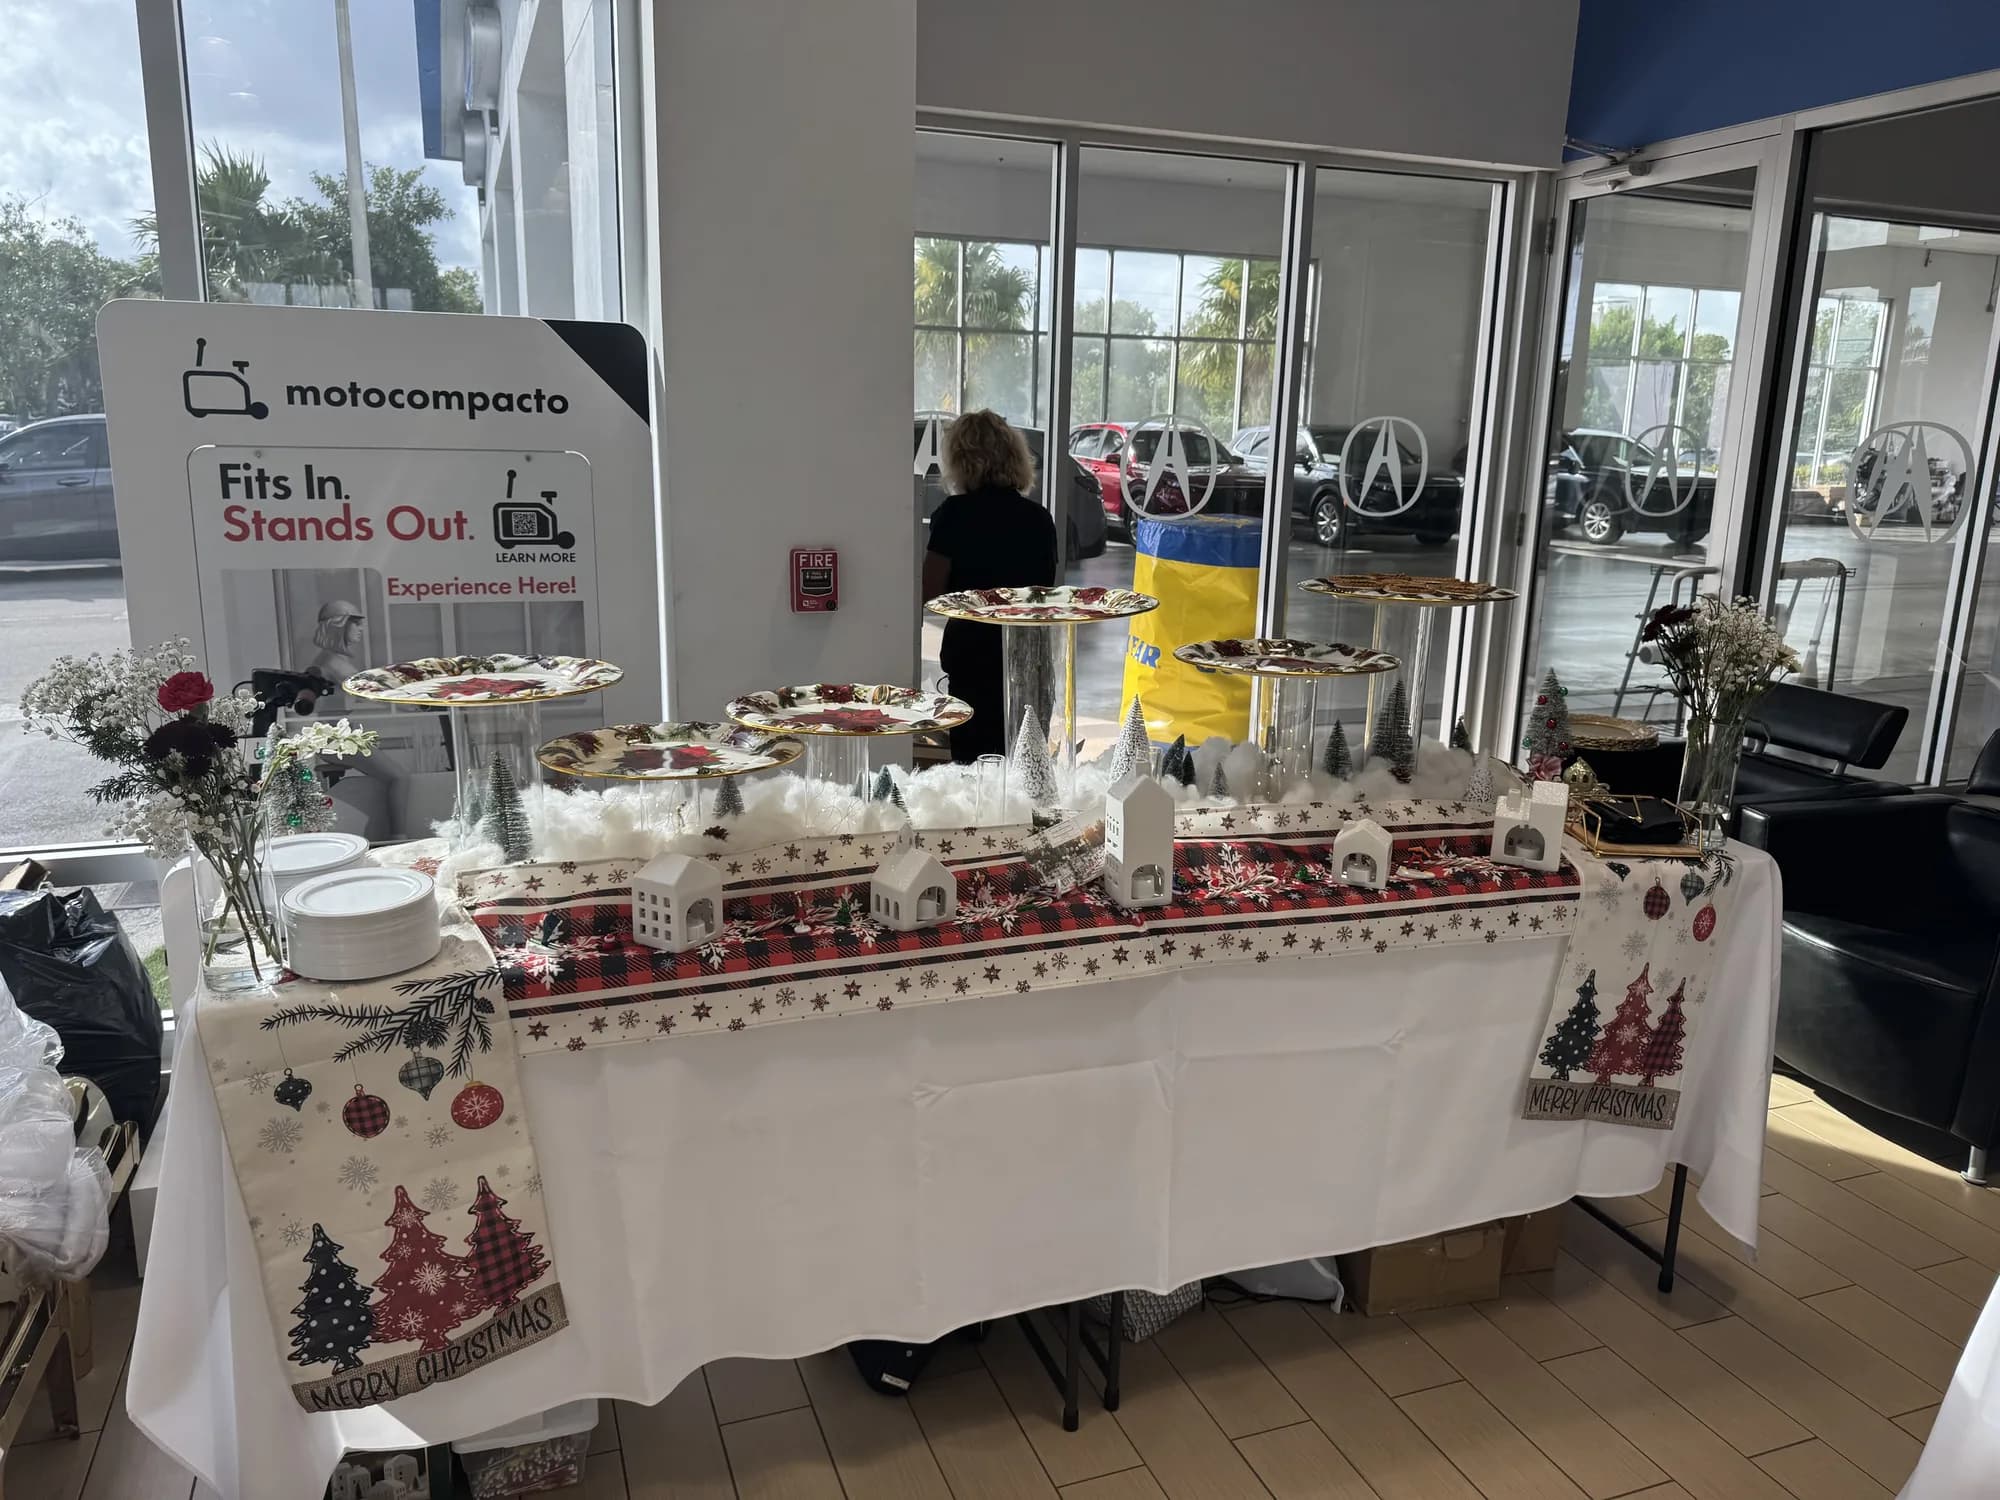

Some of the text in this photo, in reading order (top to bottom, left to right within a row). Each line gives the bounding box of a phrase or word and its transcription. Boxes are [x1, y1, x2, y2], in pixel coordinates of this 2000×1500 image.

[286, 382, 569, 419] motocompacto
[219, 463, 350, 500] Fits In.
[223, 503, 474, 542] Stands Out.
[496, 552, 576, 563] LEARN MORE
[799, 554, 833, 567] FIRE
[387, 576, 576, 600] Experience Here!
[1529, 1085, 1584, 1115] MERRY
[310, 1297, 553, 1410] MERRY CHRISTMAS
